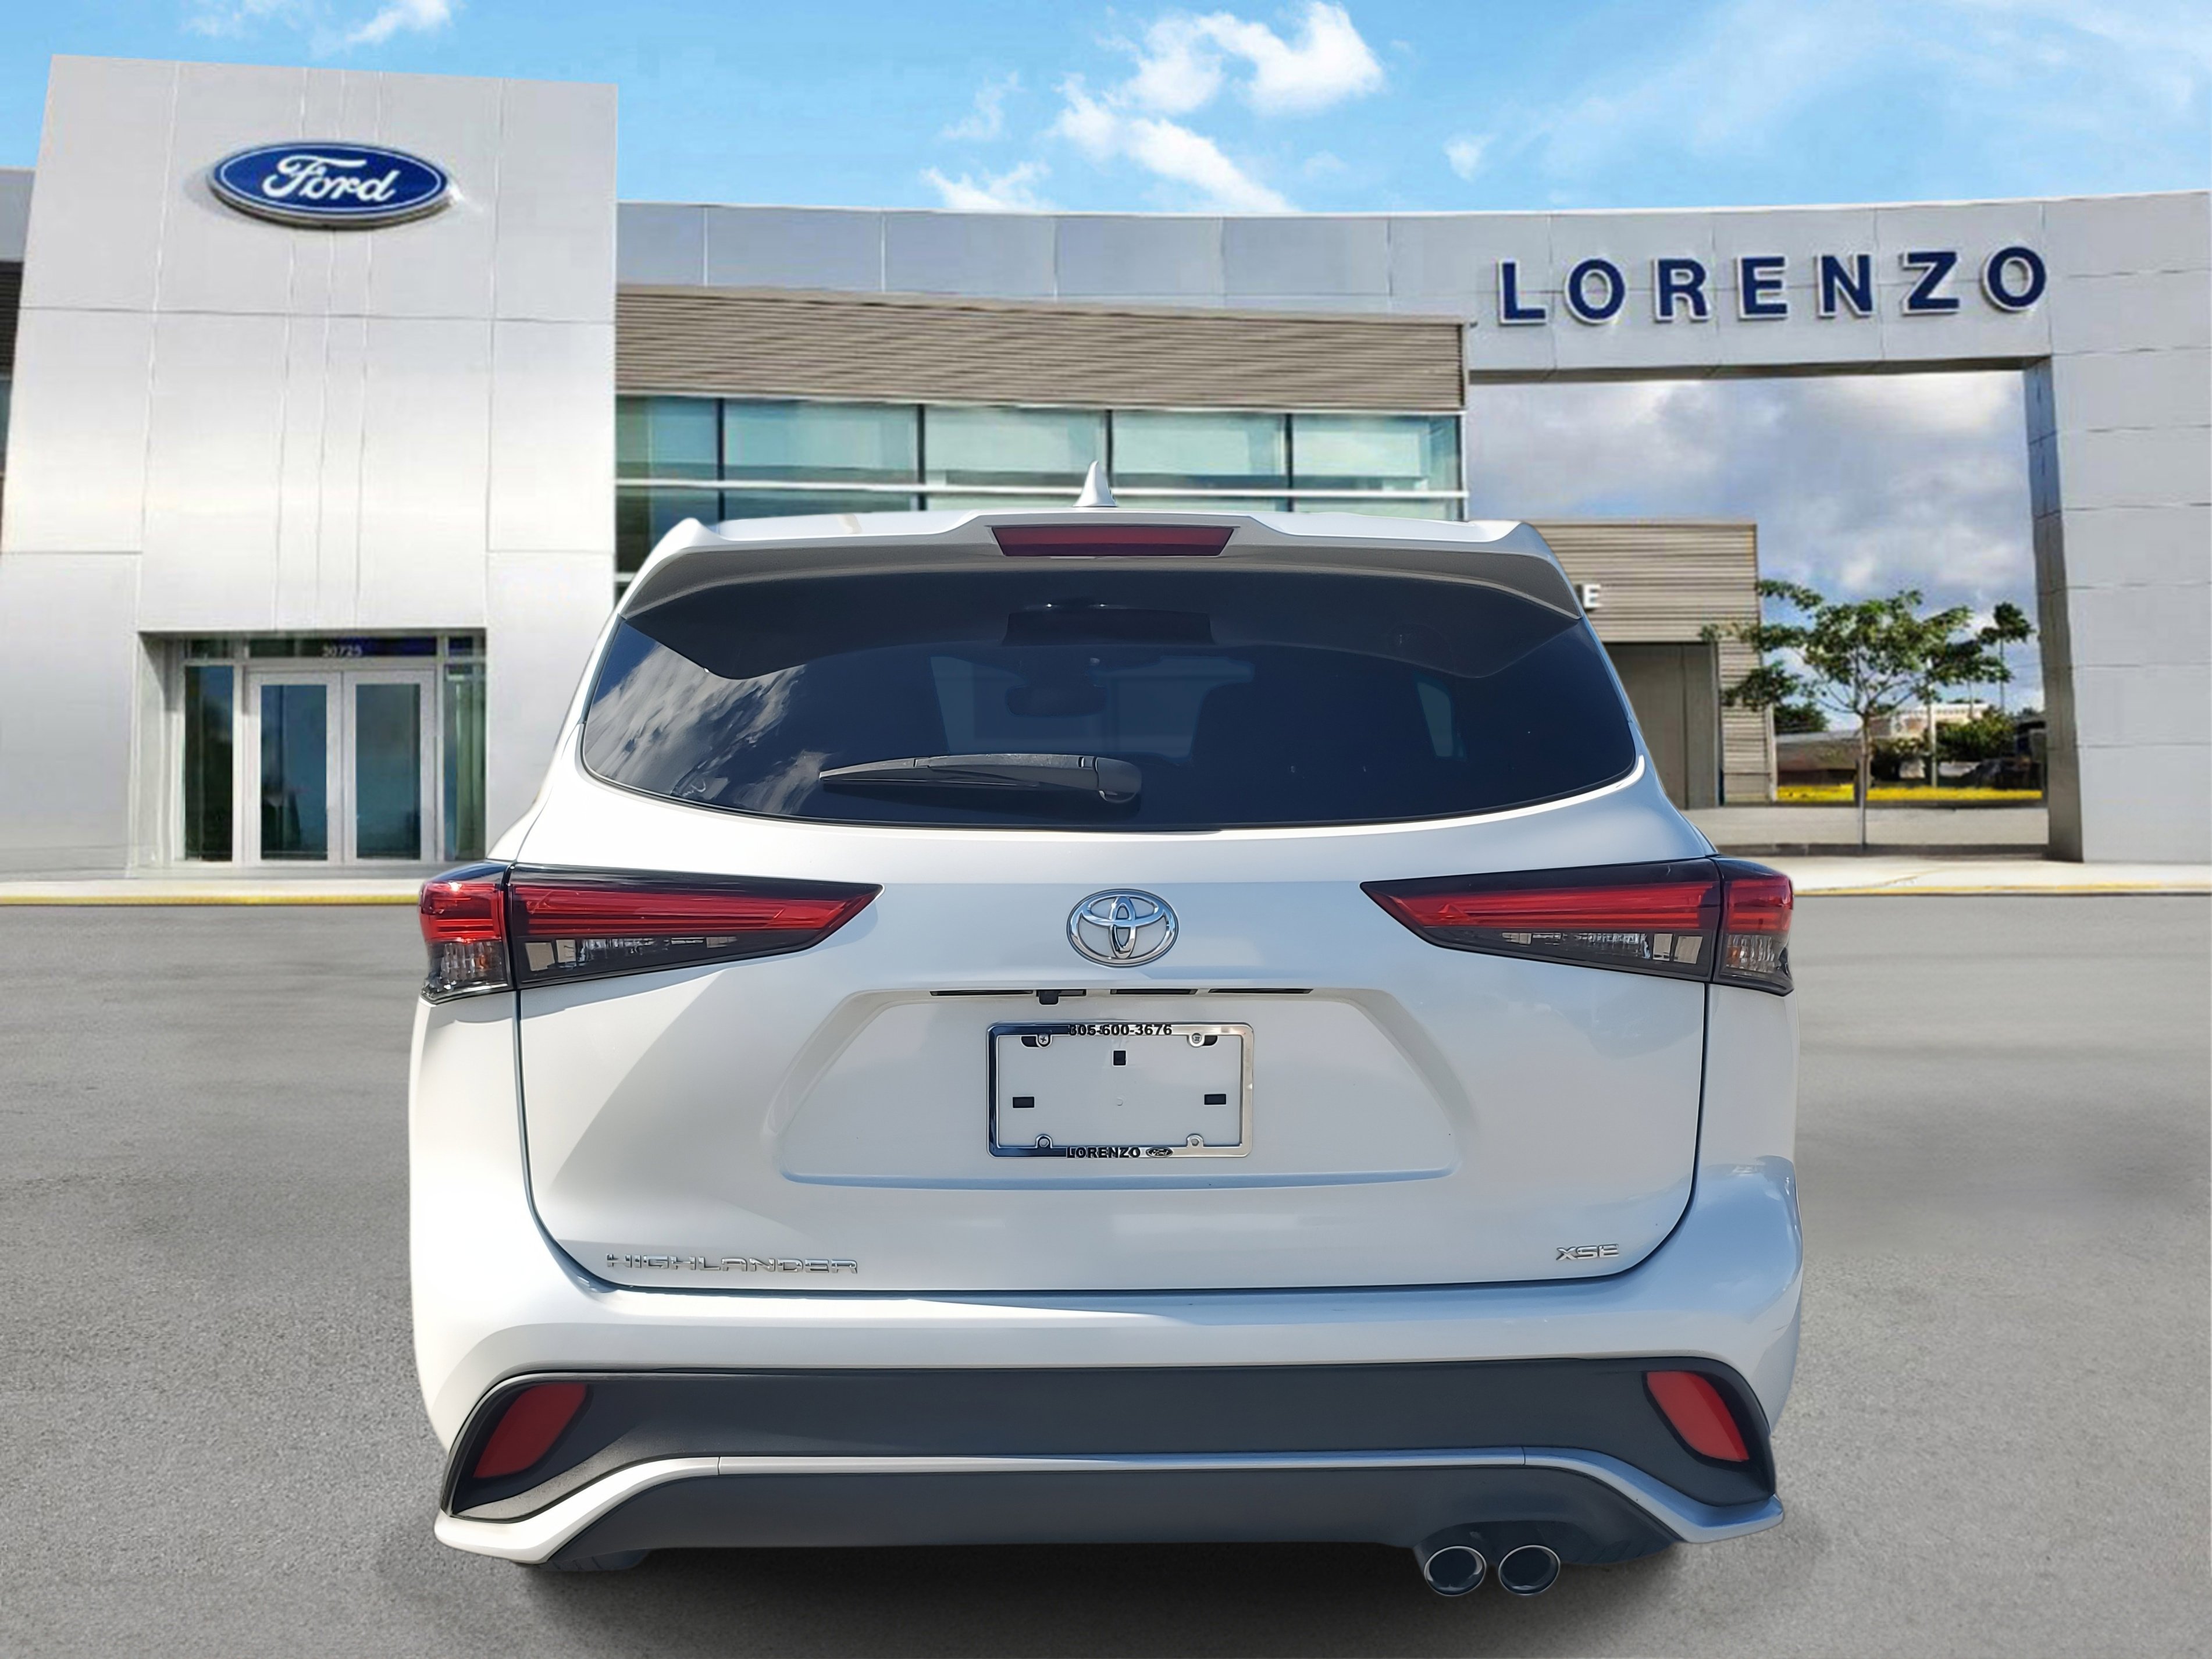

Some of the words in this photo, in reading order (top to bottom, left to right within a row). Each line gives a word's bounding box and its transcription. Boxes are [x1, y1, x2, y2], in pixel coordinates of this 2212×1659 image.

[261, 155, 401, 202] Ford
[1497, 245, 2048, 325] LORENZO
[1068, 1023, 1173, 1036] 305-600-3676
[1066, 1146, 1141, 1159] LORENZO
[1555, 1243, 1620, 1261] XSE
[605, 1252, 859, 1274] HIGHLANDER
